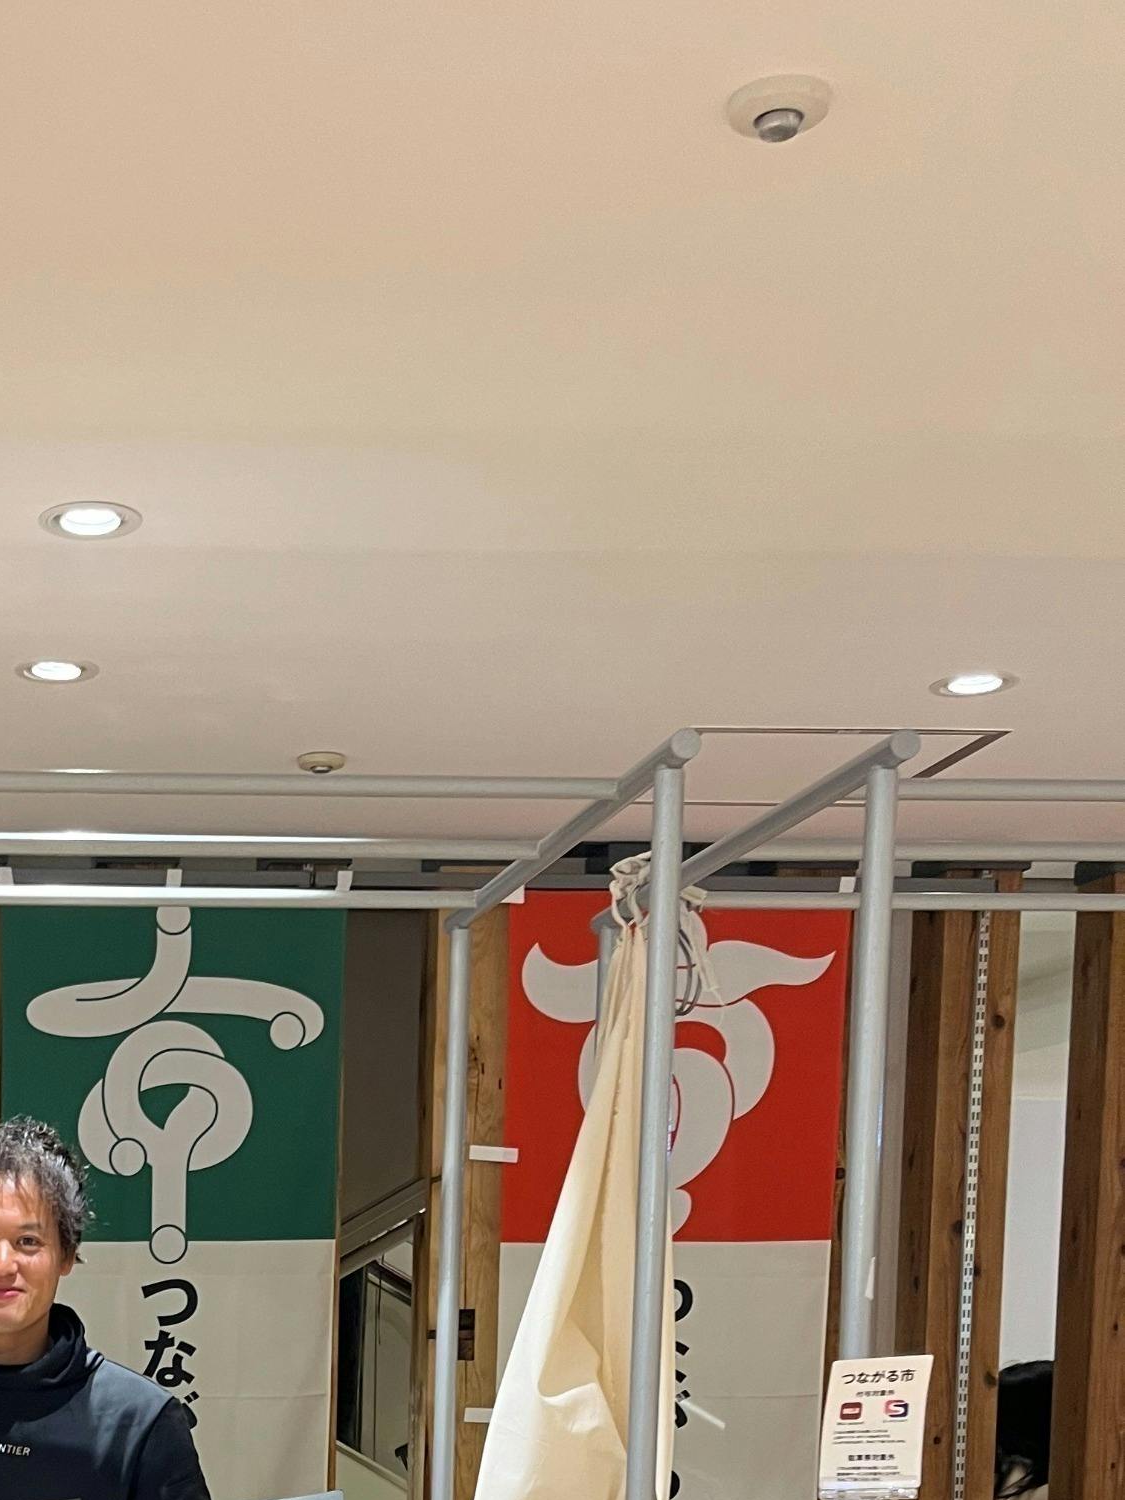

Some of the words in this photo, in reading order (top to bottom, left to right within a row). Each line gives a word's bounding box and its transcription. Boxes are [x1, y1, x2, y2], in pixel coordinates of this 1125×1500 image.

[842, 1369, 916, 1385] つながる市
